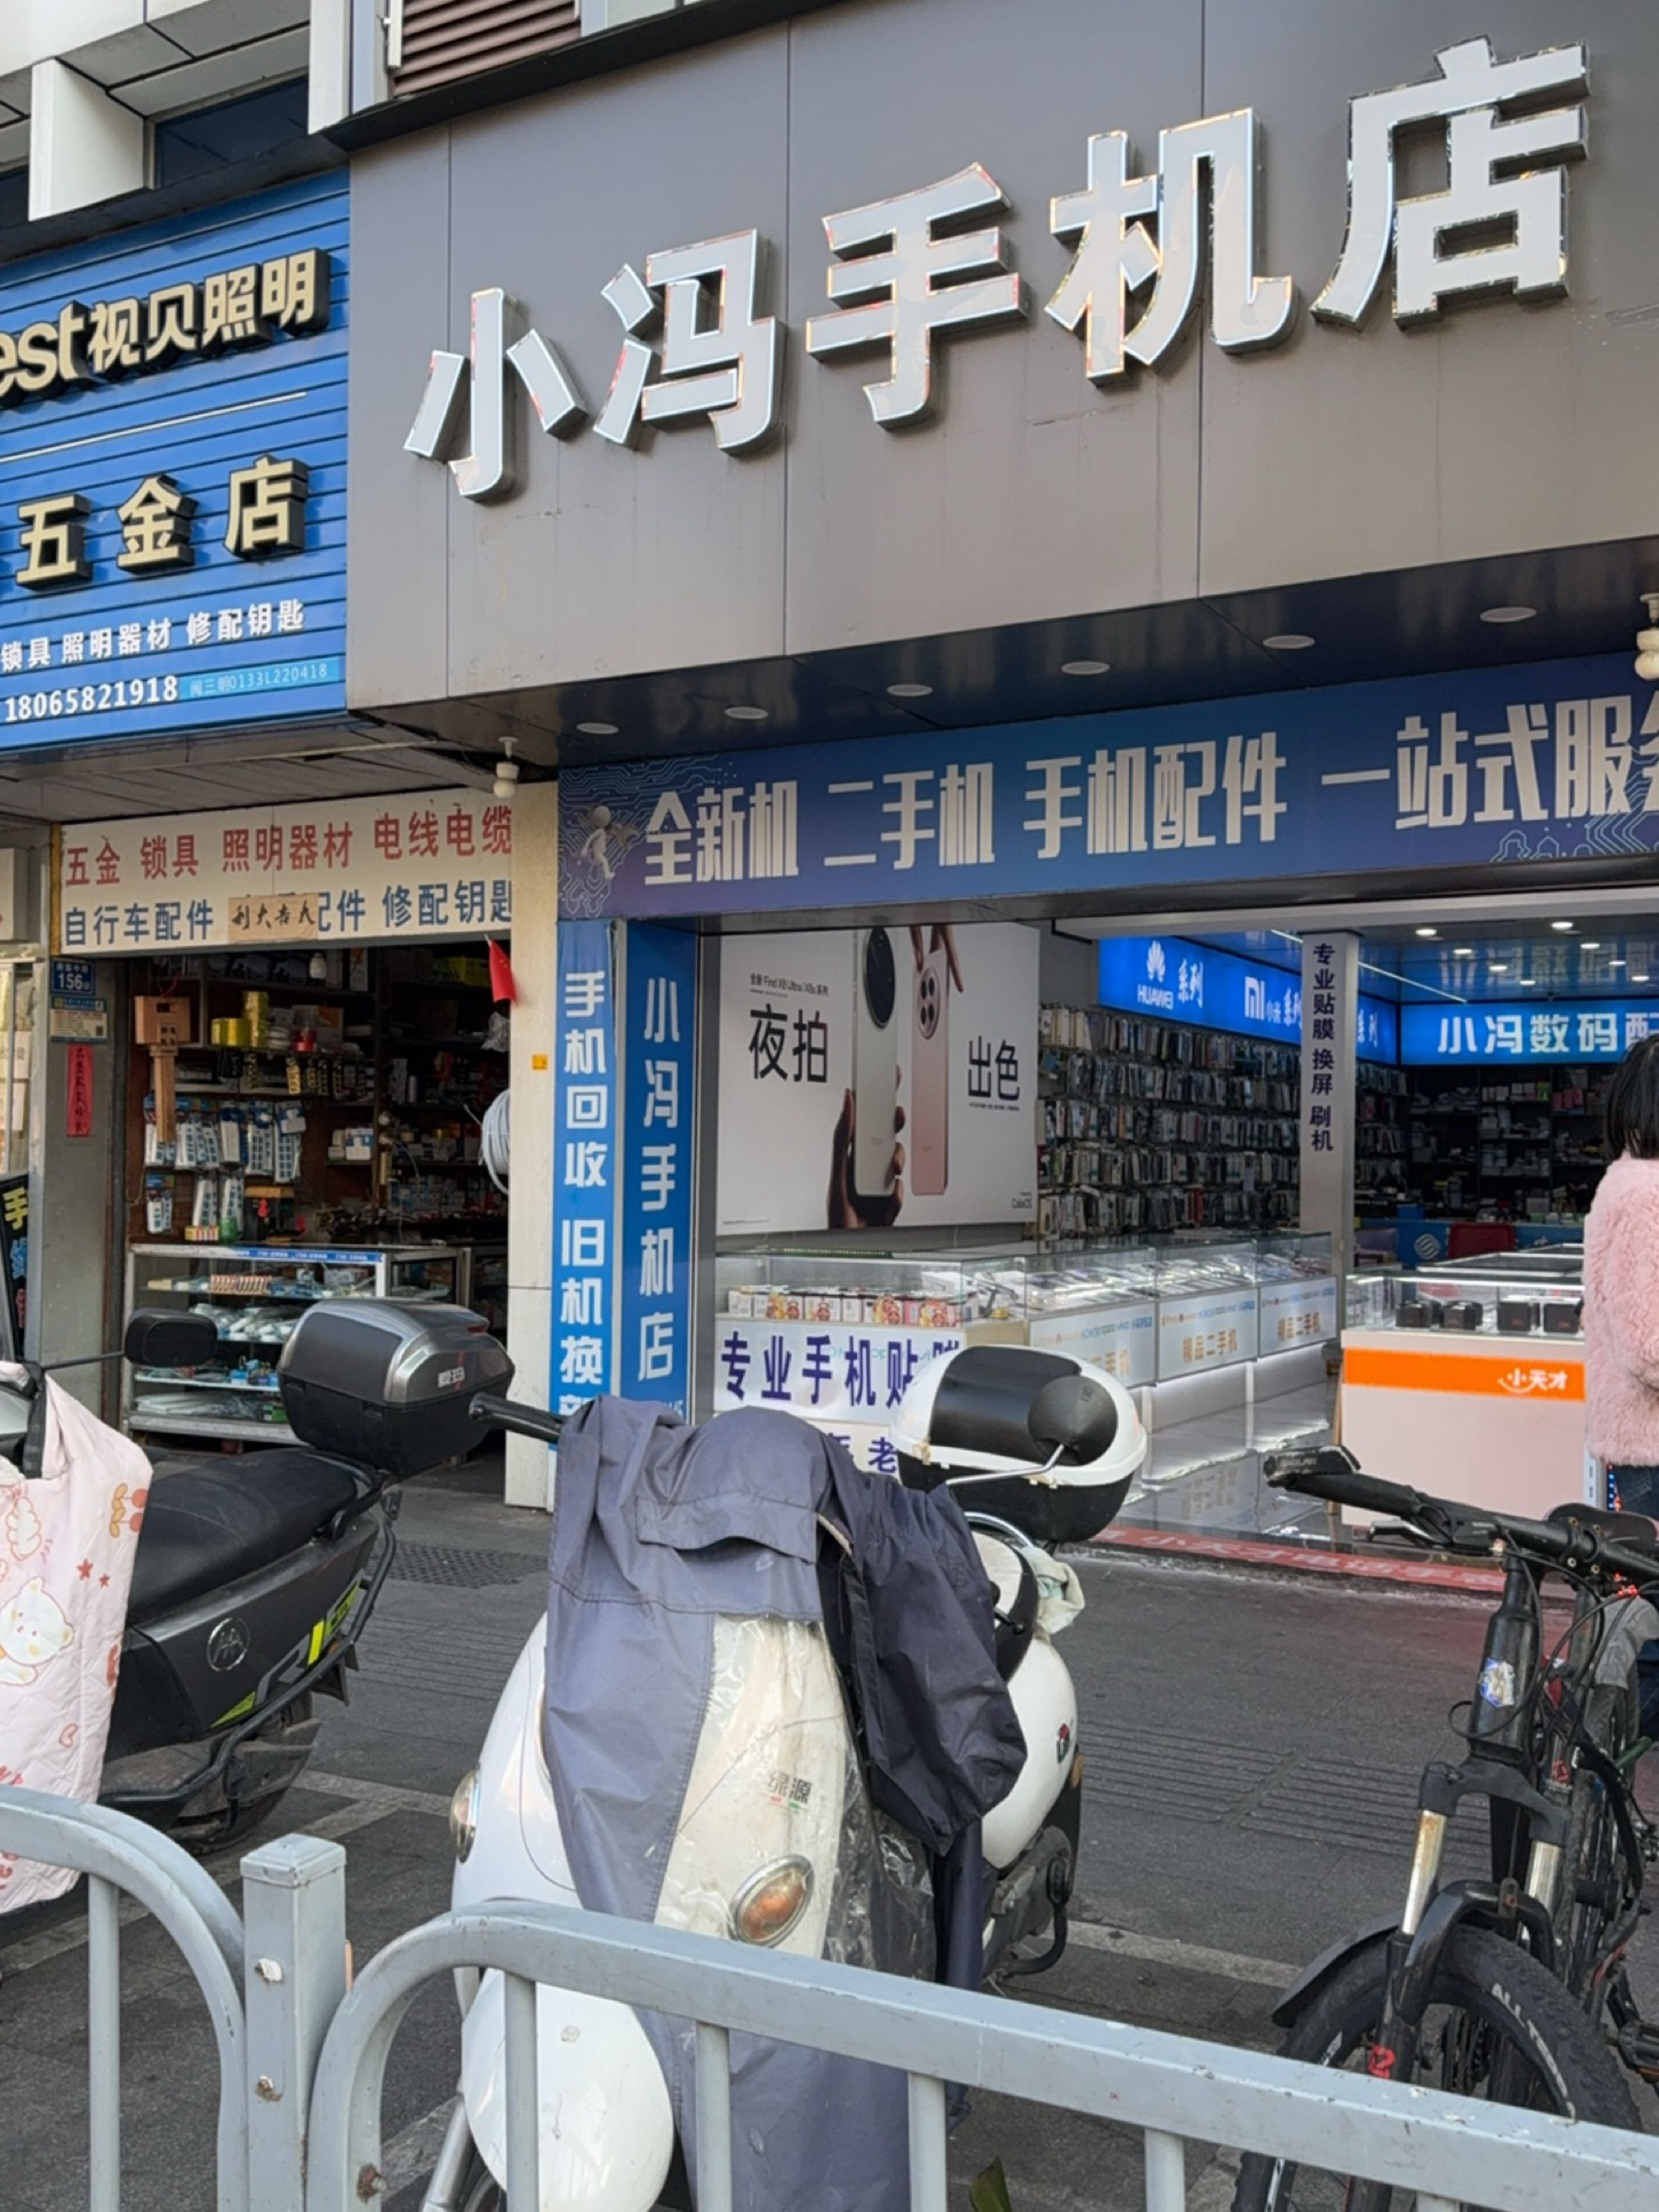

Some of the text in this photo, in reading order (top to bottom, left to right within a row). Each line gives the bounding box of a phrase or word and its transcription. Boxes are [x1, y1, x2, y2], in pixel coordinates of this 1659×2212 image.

[405, 35, 1591, 501] 小冯手机店
[1, 598, 306, 671] 锁具 照明器材 修配钥匙
[4, 675, 179, 723] 18065821918
[644, 691, 1659, 886] 全新机 二手机 手机配件 一站式服
[65, 805, 511, 886] 五金 锁具 照明器材 电线电缆
[65, 899, 214, 947] 自行车配件
[382, 879, 511, 927] 修配钥匙
[1137, 984, 1174, 1010] HUAWEI
[1178, 958, 1203, 1009] 系列
[564, 970, 607, 1187] 手机回收
[748, 1004, 828, 1083] 夜拍
[968, 1036, 1020, 1101] 出色
[1309, 943, 1336, 1152] 专业贴膜 换屏 刷机
[638, 977, 680, 1382] 小冯手机店
[721, 1331, 959, 1409] 专业手机贴
[1497, 1367, 1569, 1393] 小天才
